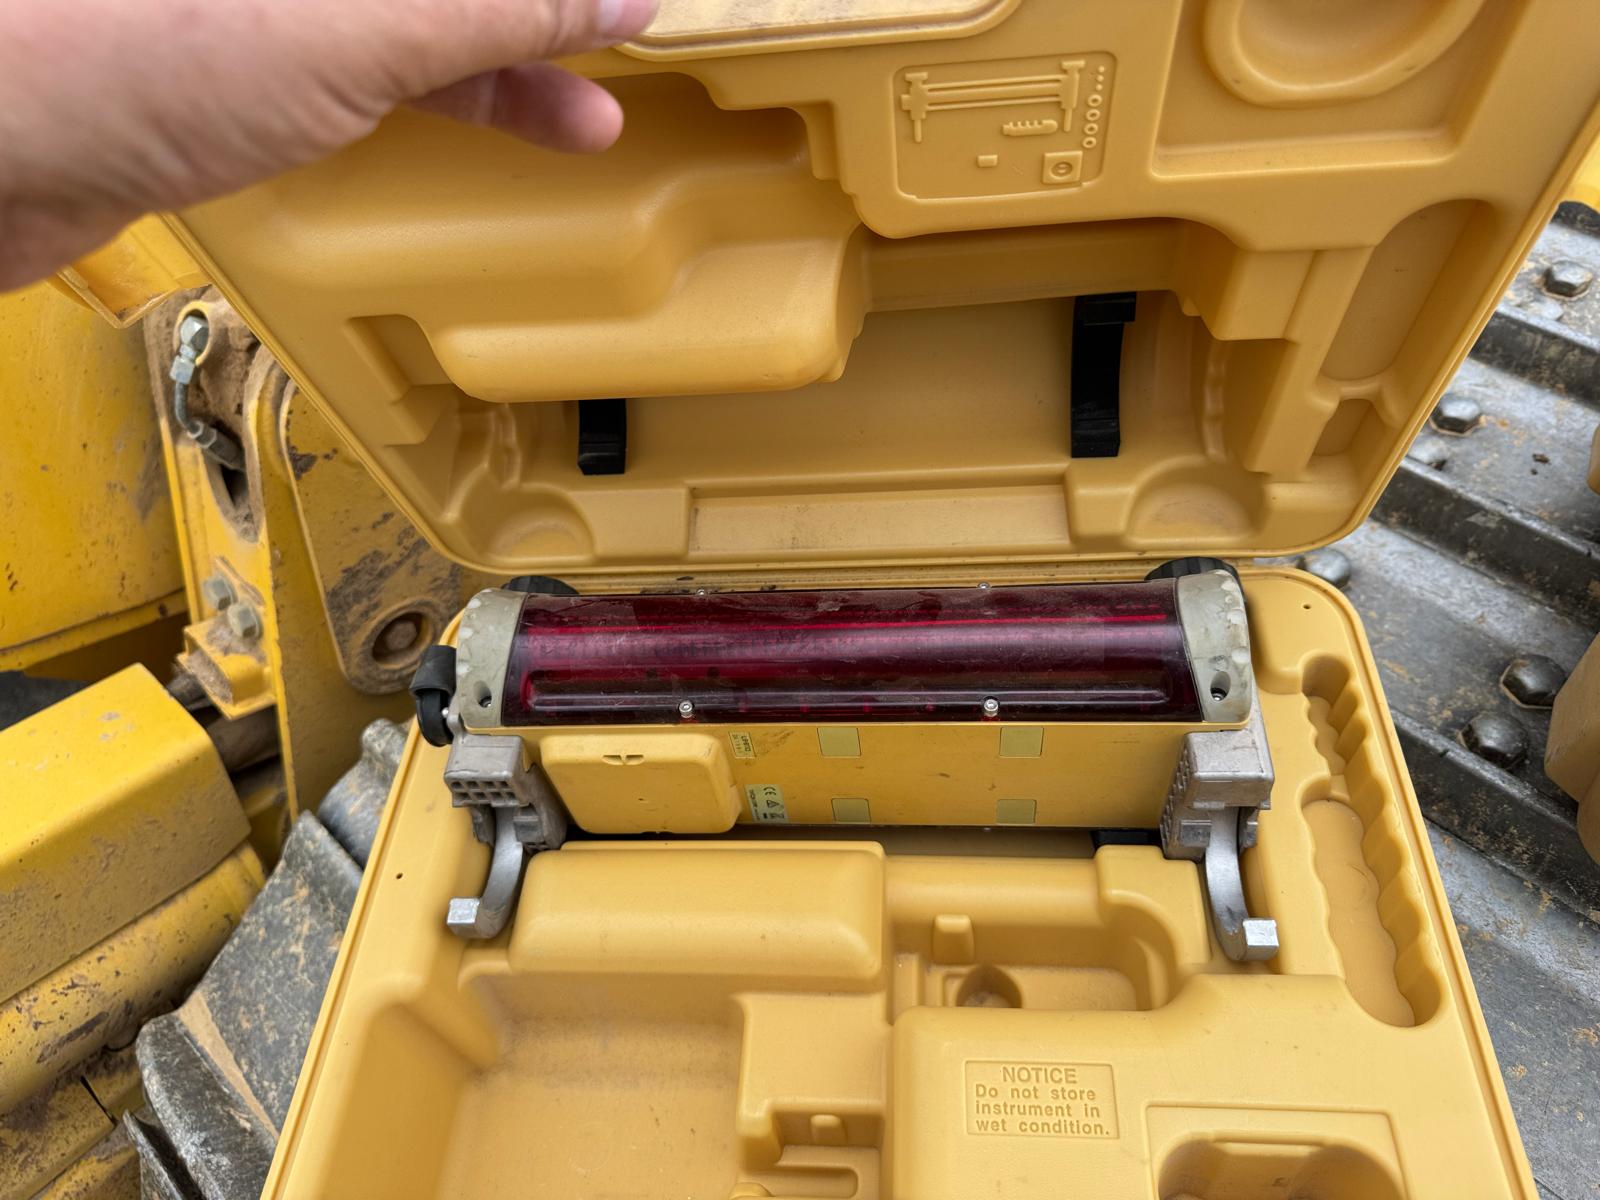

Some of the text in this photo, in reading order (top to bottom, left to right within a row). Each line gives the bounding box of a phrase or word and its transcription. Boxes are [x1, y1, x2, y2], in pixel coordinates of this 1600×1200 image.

[1002, 1066, 1078, 1084] NOTICE
[975, 1083, 1097, 1101] Do not store
[975, 1100, 1100, 1118] instrument in
[975, 1118, 1110, 1136] wet condition.
